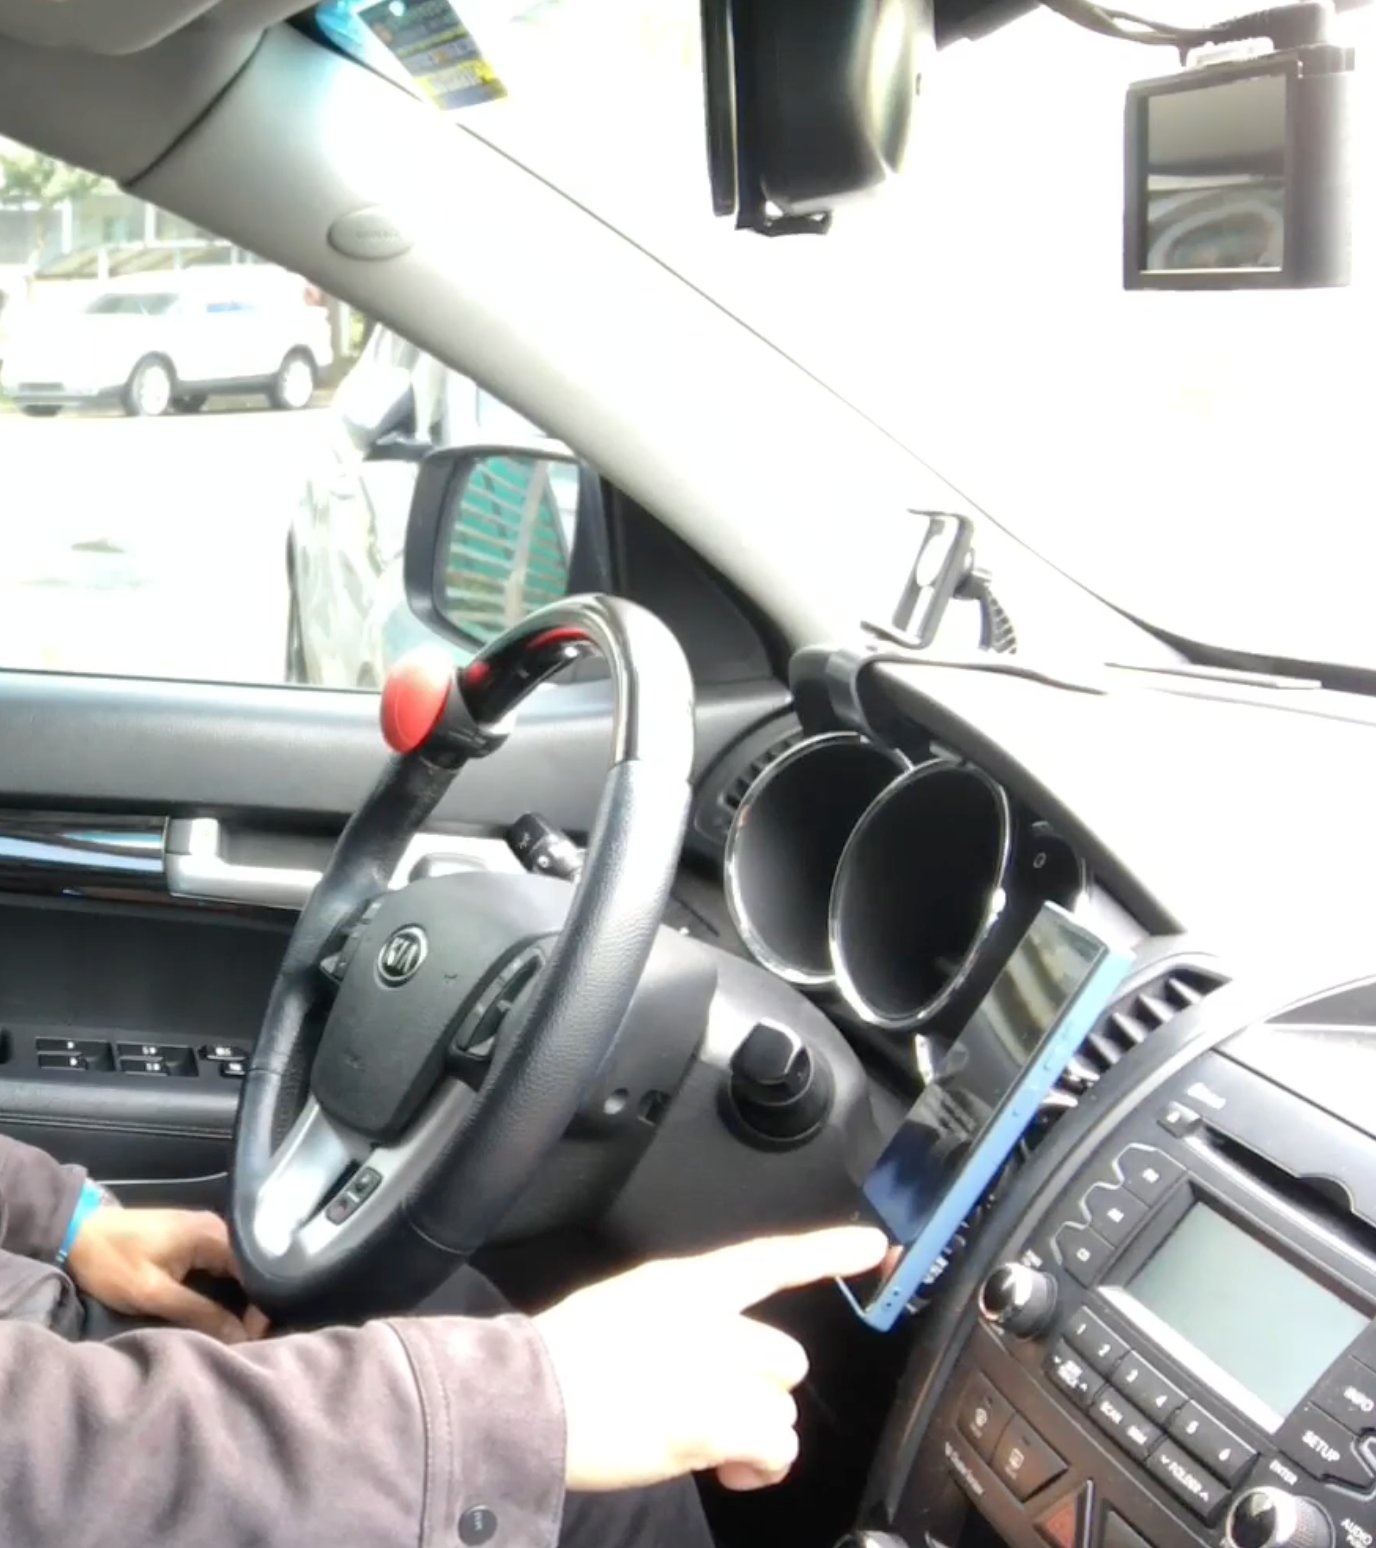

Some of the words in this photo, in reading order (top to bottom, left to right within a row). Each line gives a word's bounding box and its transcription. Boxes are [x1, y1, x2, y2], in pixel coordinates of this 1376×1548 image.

[1077, 1323, 1086, 1335] 1
[1098, 1343, 1111, 1357] 2
[1126, 1369, 1139, 1383] 3
[1155, 1394, 1168, 1408] 4
[1186, 1420, 1199, 1434] 5
[1301, 1430, 1341, 1462] SETUP
[1218, 1448, 1231, 1462] 6
[1168, 1461, 1203, 1494] FOLDER
[1269, 1458, 1299, 1486] ENTER
[1340, 1518, 1373, 1546] AUDIO
